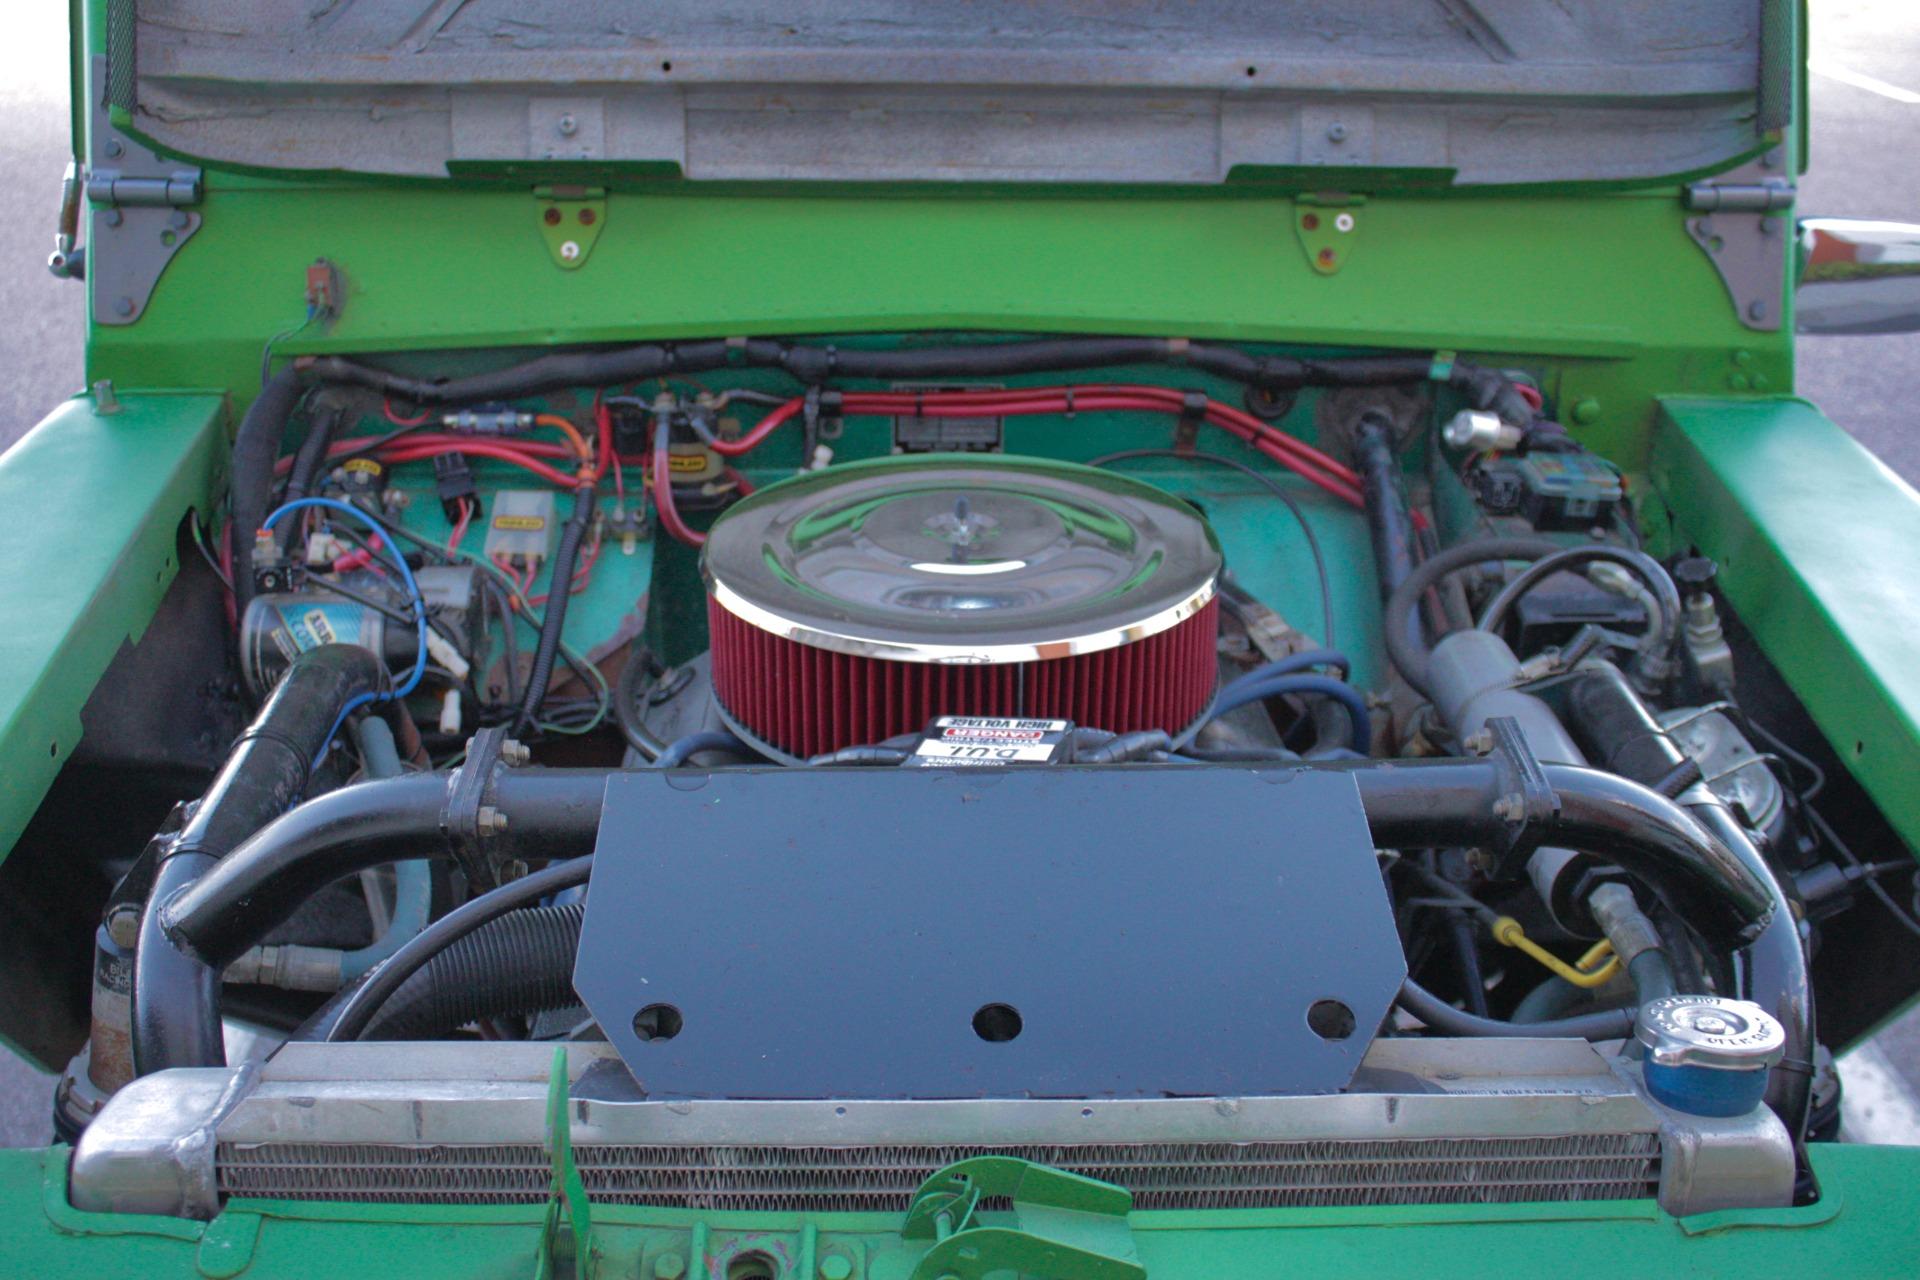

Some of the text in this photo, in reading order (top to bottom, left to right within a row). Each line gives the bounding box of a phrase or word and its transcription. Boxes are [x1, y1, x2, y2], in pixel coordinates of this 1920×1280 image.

[950, 717, 1054, 730] HIGH VOLTAGE
[954, 727, 1037, 739] DANGER
[949, 745, 1021, 759] D.U.I.
